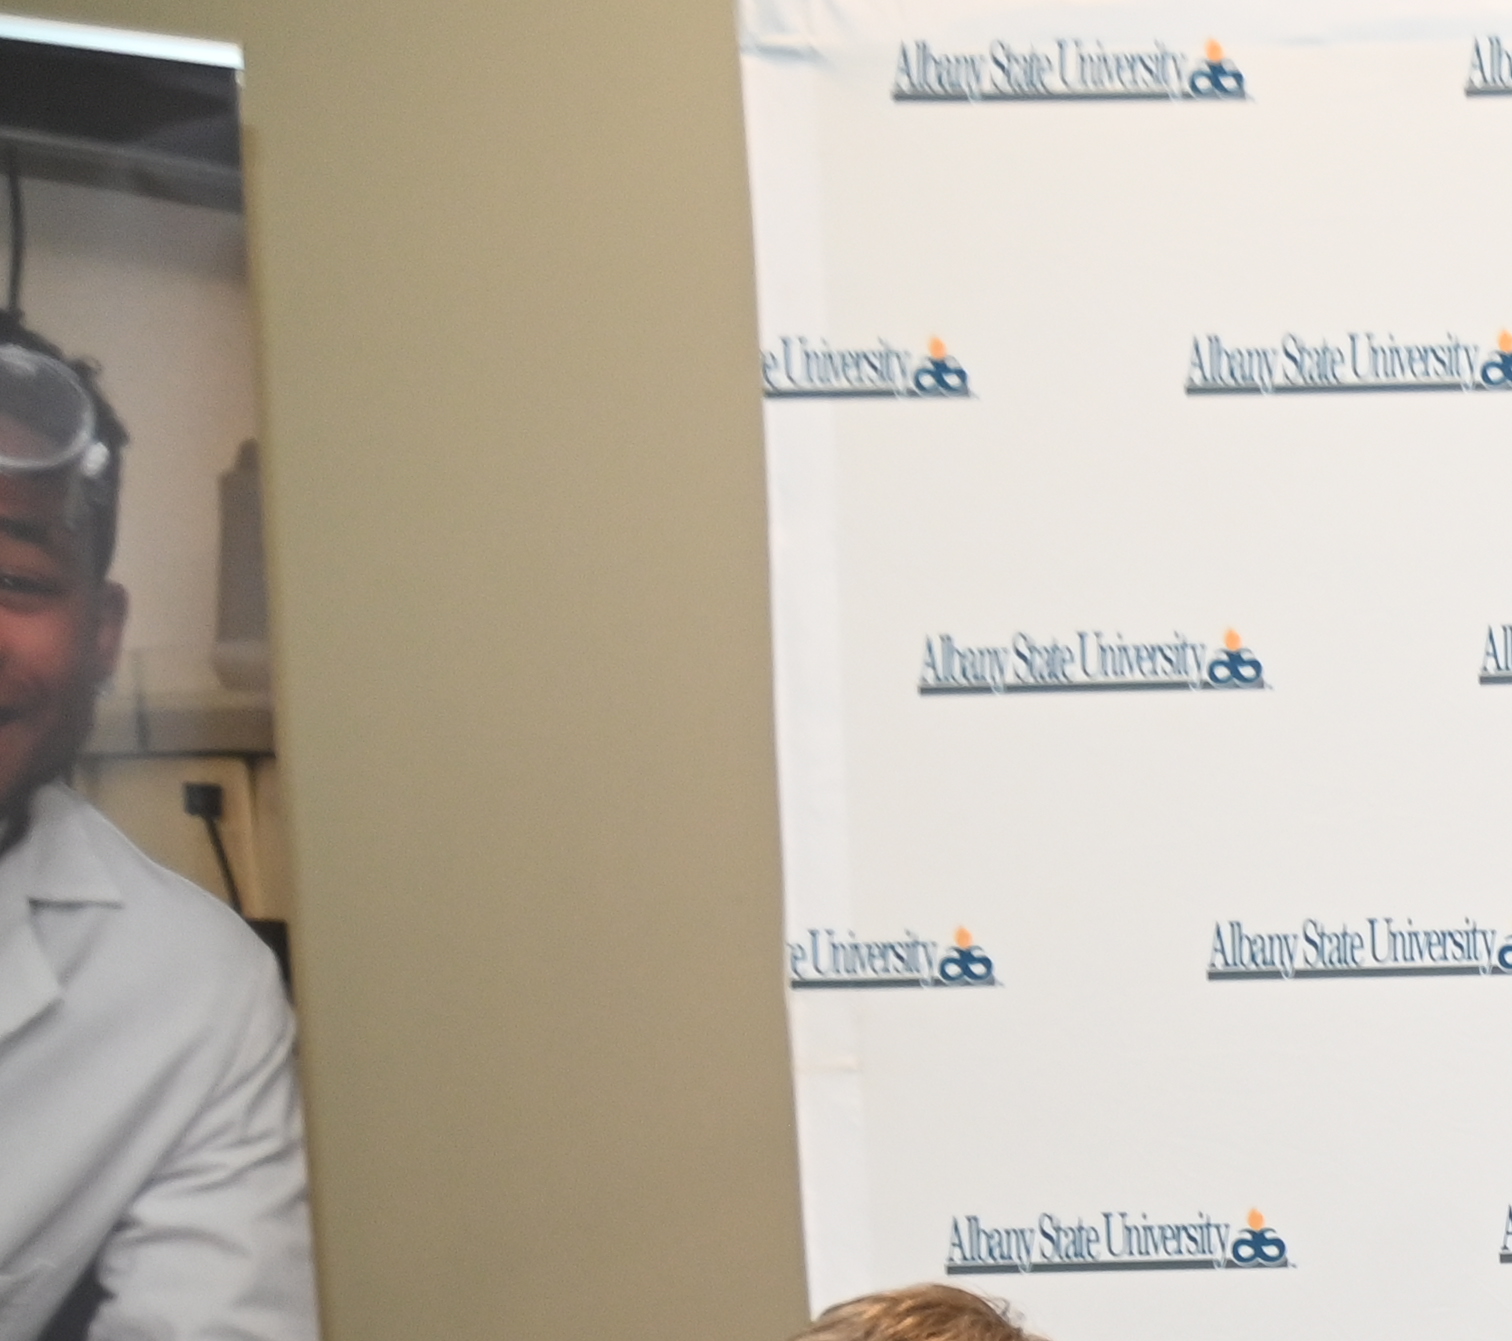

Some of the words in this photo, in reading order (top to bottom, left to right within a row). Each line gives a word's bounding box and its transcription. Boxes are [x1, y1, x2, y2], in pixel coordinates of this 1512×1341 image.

[894, 41, 985, 102] Albany
[989, 39, 1053, 90] State
[1055, 40, 1187, 101] University
[781, 339, 911, 398] University
[1187, 335, 1278, 394] Albany
[1281, 333, 1345, 383] State
[1348, 332, 1479, 391] University
[920, 635, 1009, 693] Albany
[1012, 632, 1075, 682] State
[1077, 630, 1206, 690] University
[808, 929, 936, 986] University
[1209, 921, 1298, 979] Albany
[1302, 918, 1365, 967] State
[1367, 916, 1496, 975] University
[947, 1216, 1035, 1273] Albany
[1038, 1212, 1101, 1261] State
[1102, 1210, 1230, 1269] University
